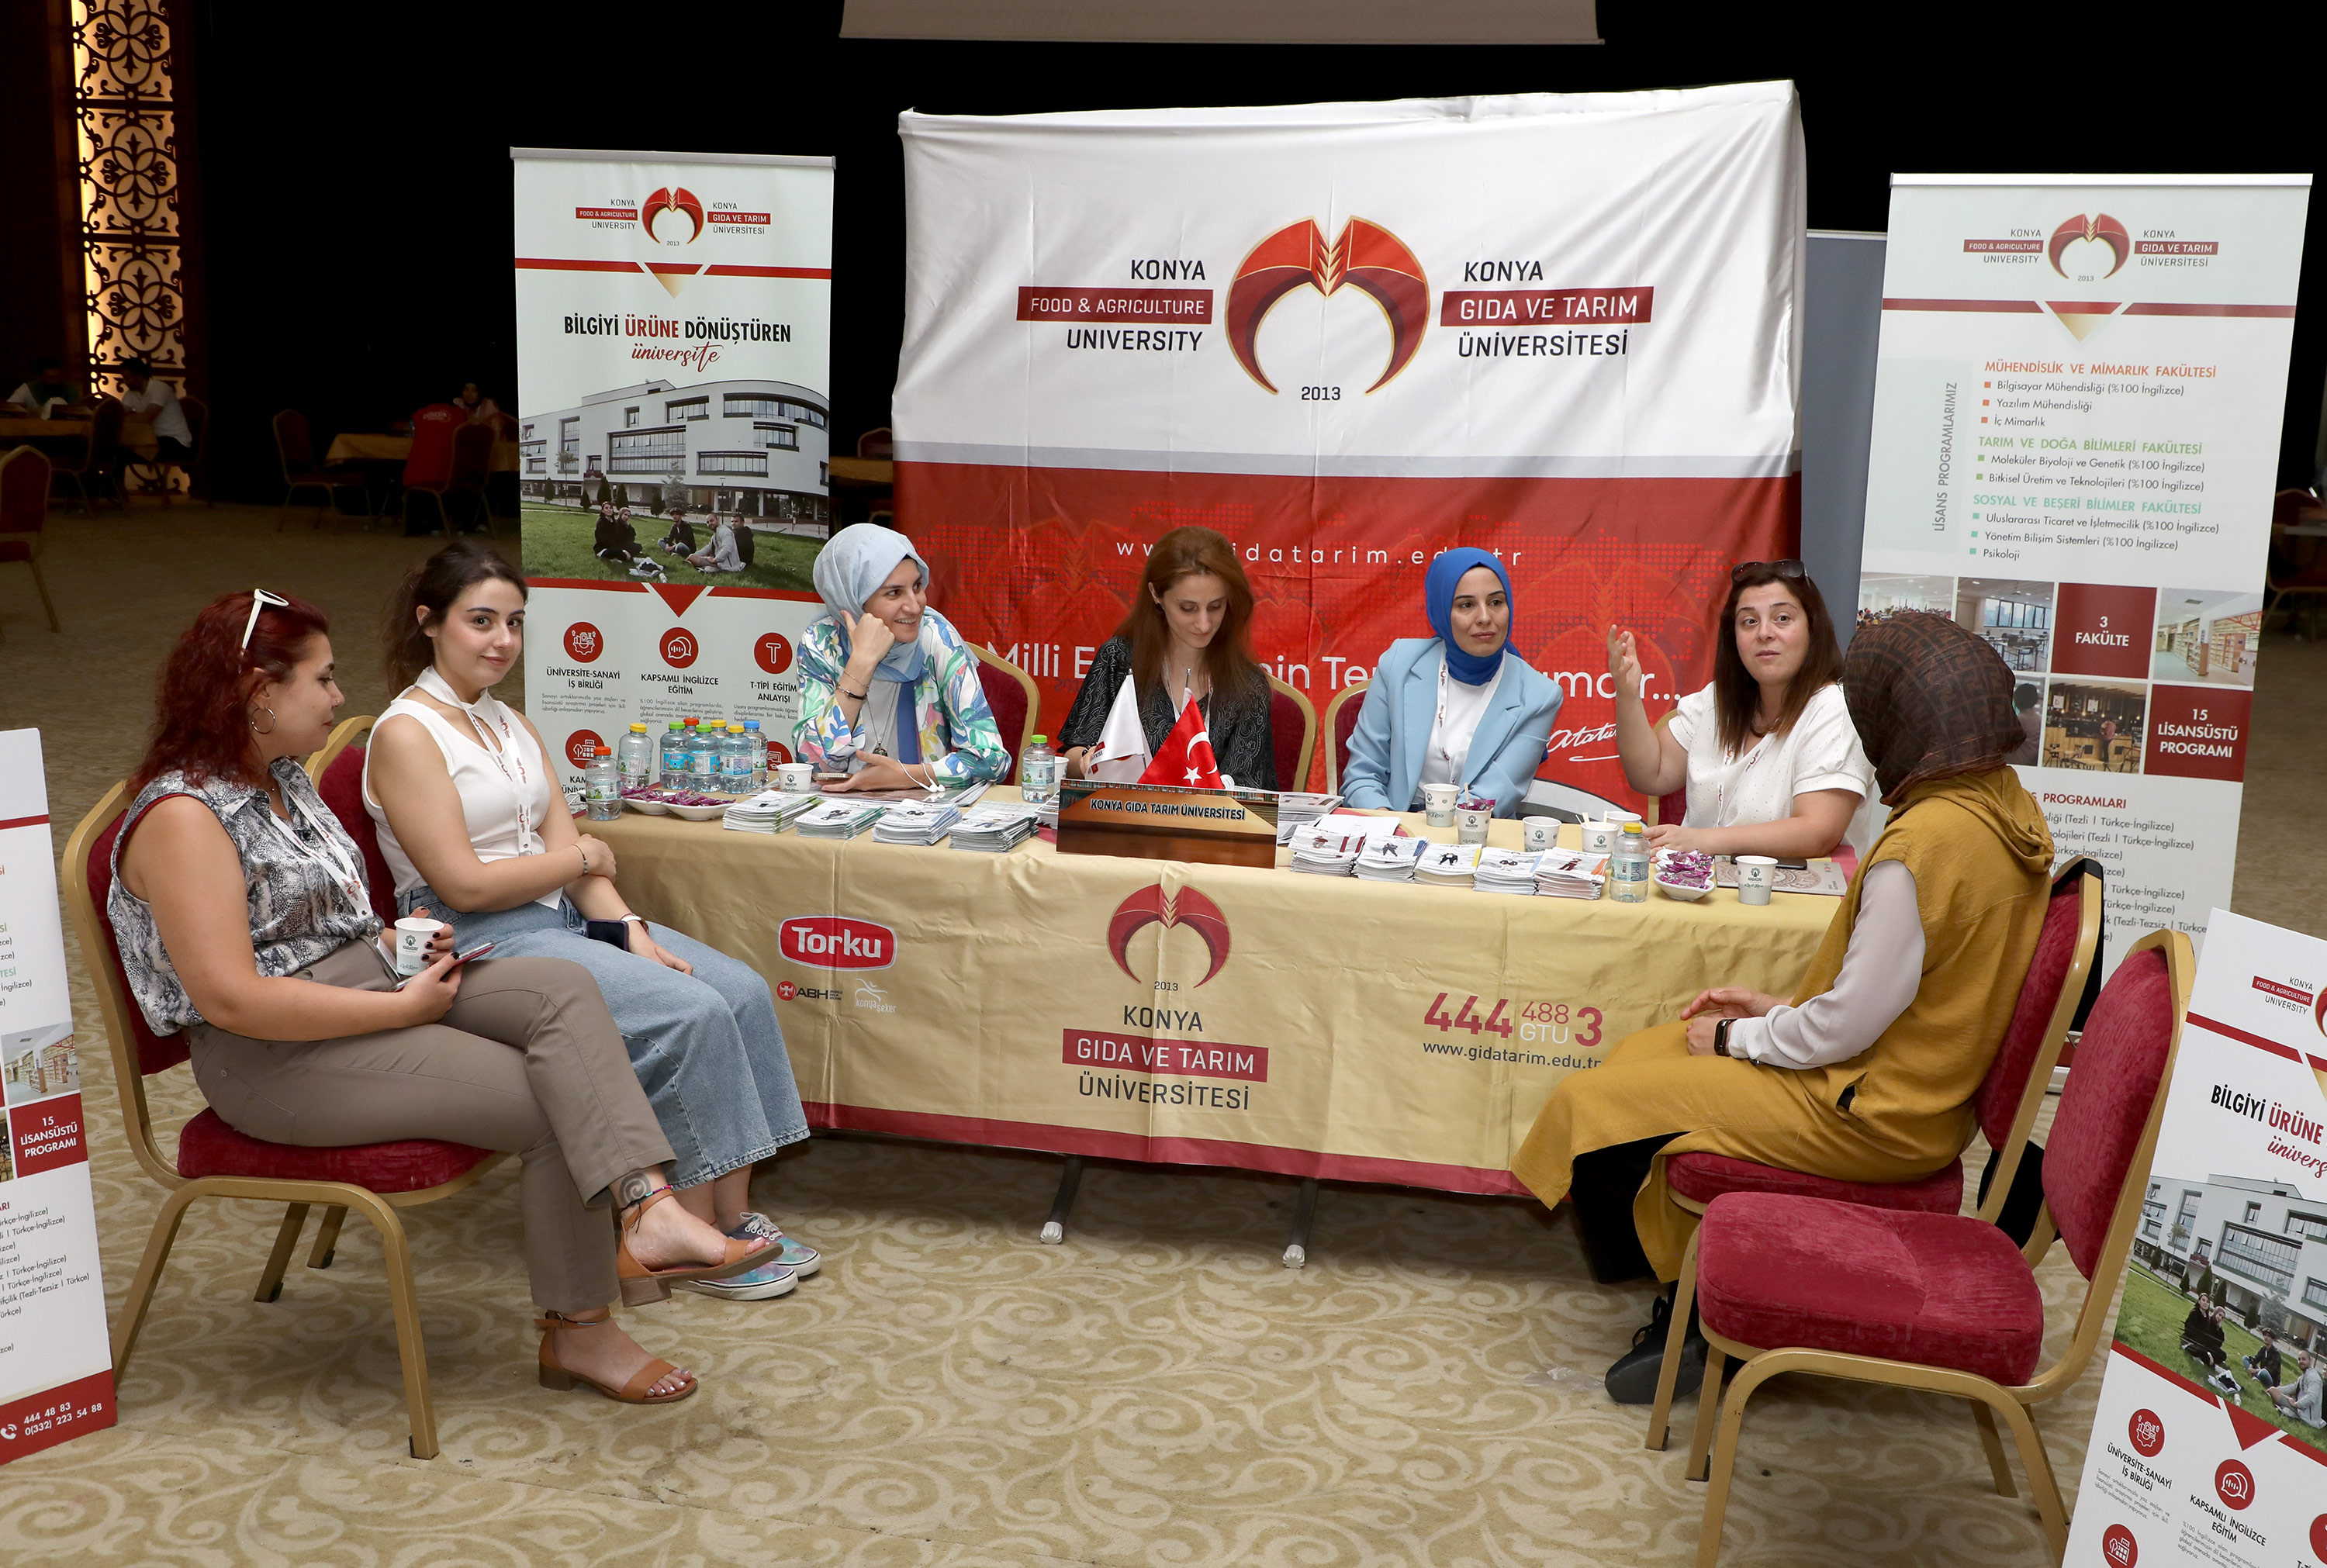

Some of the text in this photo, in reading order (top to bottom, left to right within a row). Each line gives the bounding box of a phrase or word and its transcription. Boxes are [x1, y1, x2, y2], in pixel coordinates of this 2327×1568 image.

[713, 226, 765, 234] ÜNİVERSİTESİ
[2011, 229, 2042, 237] KONYA
[2143, 230, 2175, 239] KONYA
[1996, 243, 2041, 251] AGRICULTURE
[2142, 243, 2212, 254] GIDA VE TARIM
[1983, 255, 2039, 264] UNIVERSITY
[2140, 256, 2209, 267] ÜNİVERSİTESİ
[1131, 260, 1206, 280] KONYA
[1464, 261, 1544, 282] KONYA
[1031, 298, 1205, 315] FOOD & AGRICULTURE
[1460, 295, 1637, 319] GIDA VE TARIM
[564, 313, 791, 344] BİLGİYİ ÜRÜNE DÖNÜŞTÜREN
[1067, 329, 1203, 351] UNIVERSITY
[1458, 330, 1628, 357] ÜNİVERSİTESİ
[631, 343, 724, 372] üniversite
[1985, 361, 2216, 378] MÜHENDİSLİK VE MİMARLIK FAKÜLTESİ
[1301, 386, 1341, 401] 2013
[1997, 381, 2184, 396] Bilgisayar Mühendisliği (%100 İngilizce)
[1997, 399, 2092, 412] Yazılım Mühendisliği
[1994, 416, 2045, 427] İç Mimarlık
[1979, 436, 2202, 454] TARIM VE DOĞA BİLİMLERİ FAKÜLTESİ
[1932, 382, 1957, 531] LİSANS PROGRAMLARIMIZ
[1991, 455, 2036, 465] Moleküler
[2038, 456, 2073, 468] Biyoloji
[2089, 458, 2125, 468] Genetik
[2128, 460, 2159, 470] (%100
[2162, 459, 2204, 473] İngilizce)
[1989, 473, 2021, 485] Bitkisel
[2024, 473, 2052, 485] Üretim
[2069, 477, 2125, 489] Teknolojileri
[2128, 478, 2159, 489] (%100
[2162, 478, 2204, 492] İngilizce)
[1973, 495, 2201, 514] SOSYAL VE BEŞERİ BİLİMLER FAKÜLTESİ
[1986, 513, 2041, 525] Uluslararası
[2044, 516, 2074, 527] Ticaret
[2090, 516, 2139, 530] İşletmecilik
[2142, 520, 2173, 531] (%100
[2176, 520, 2219, 534] İngilizce)
[1985, 531, 2178, 551] Yönetim Bilişim Sistemleri (%100 İngilizce)
[1983, 549, 2020, 561] Psikoloji
[2100, 616, 2107, 627] 3
[2075, 630, 2129, 646] FAKÜLTE
[987, 641, 1060, 677] Milli
[546, 666, 620, 679] ÜNİVERSİTE-SANAYİ
[641, 673, 719, 686] KAPSAMLI İNGİLİZCE
[568, 679, 603, 689] İŞ BİRLİĞİ
[668, 684, 693, 695] EĞİTİM
[750, 681, 797, 692] T-TİPİ EĞİTİM
[758, 693, 790, 703] ANLAYIŞI
[2192, 709, 2208, 720] 15
[2158, 722, 2238, 741] LİSANSÜSTÜ
[2159, 741, 2232, 758] PROGRAMI
[1091, 799, 1245, 820] KONYA GIDA TARIM ÜNİVERSİTESİ
[2043, 793, 2127, 808] PROGRAMLARI
[2065, 814, 2088, 824] (Tezli
[2101, 817, 2174, 831] Türkçe-İngilizce)
[2087, 832, 2110, 843] (Tezli
[2123, 835, 2194, 850] Türkçe-İngilizce)
[2055, 846, 2123, 860] ürkçe-İngilizce)
[2111, 885, 2184, 900] Türkçe-İngilizce)
[2114, 917, 2166, 928] (Tezli-Tezsiz
[791, 927, 882, 958] Torku
[1153, 980, 1179, 992] 2013
[2256, 981, 2270, 989] FOOD
[2276, 987, 2311, 1003] AGRICULTURE
[2289, 977, 2313, 990] KONYA
[797, 987, 828, 999] ABH
[856, 998, 877, 1009] konya
[2265, 995, 2308, 1014] UNIVERSITY
[1124, 1005, 1203, 1032] KONYA
[1424, 993, 1603, 1047] 444 488 3
[1520, 1023, 1568, 1044] GTU
[1077, 1038, 1254, 1074] GIDA VE TARIM
[1423, 1043, 1602, 1069] www.gidatarim.edu.tr
[1078, 1070, 1250, 1110] ÜNİVERSİTESİ
[42, 1116, 54, 1126] 15
[2211, 1084, 2324, 1145] BİLGİYİ ÜRÜNE
[20, 1121, 78, 1145] LİSANSÜSTÜ
[25, 1138, 76, 1158] PROGRAMI
[0, 1207, 48, 1225] rkçe-İngilizce)
[12, 1215, 65, 1235] Türkçe-İngilizce)
[12, 1255, 67, 1276] Türkçe-İngilizce)
[8, 1268, 62, 1290] Türkçe-İngilizce)
[67, 1273, 89, 1285] Türkçe)
[23, 1402, 71, 1425] 444 48 83
[25, 1403, 102, 1436] 0(332) 223 54 88
[2107, 1442, 2173, 1490] ÜNİVERSİTE-SANAYİ
[2122, 1465, 2153, 1491] İŞ BİRLİĞİ
[2190, 1494, 2228, 1522] KAPSAMLI
[2230, 1516, 2266, 1546] İNGİLİZCE
[2211, 1521, 2237, 1543] EĞİTİM
